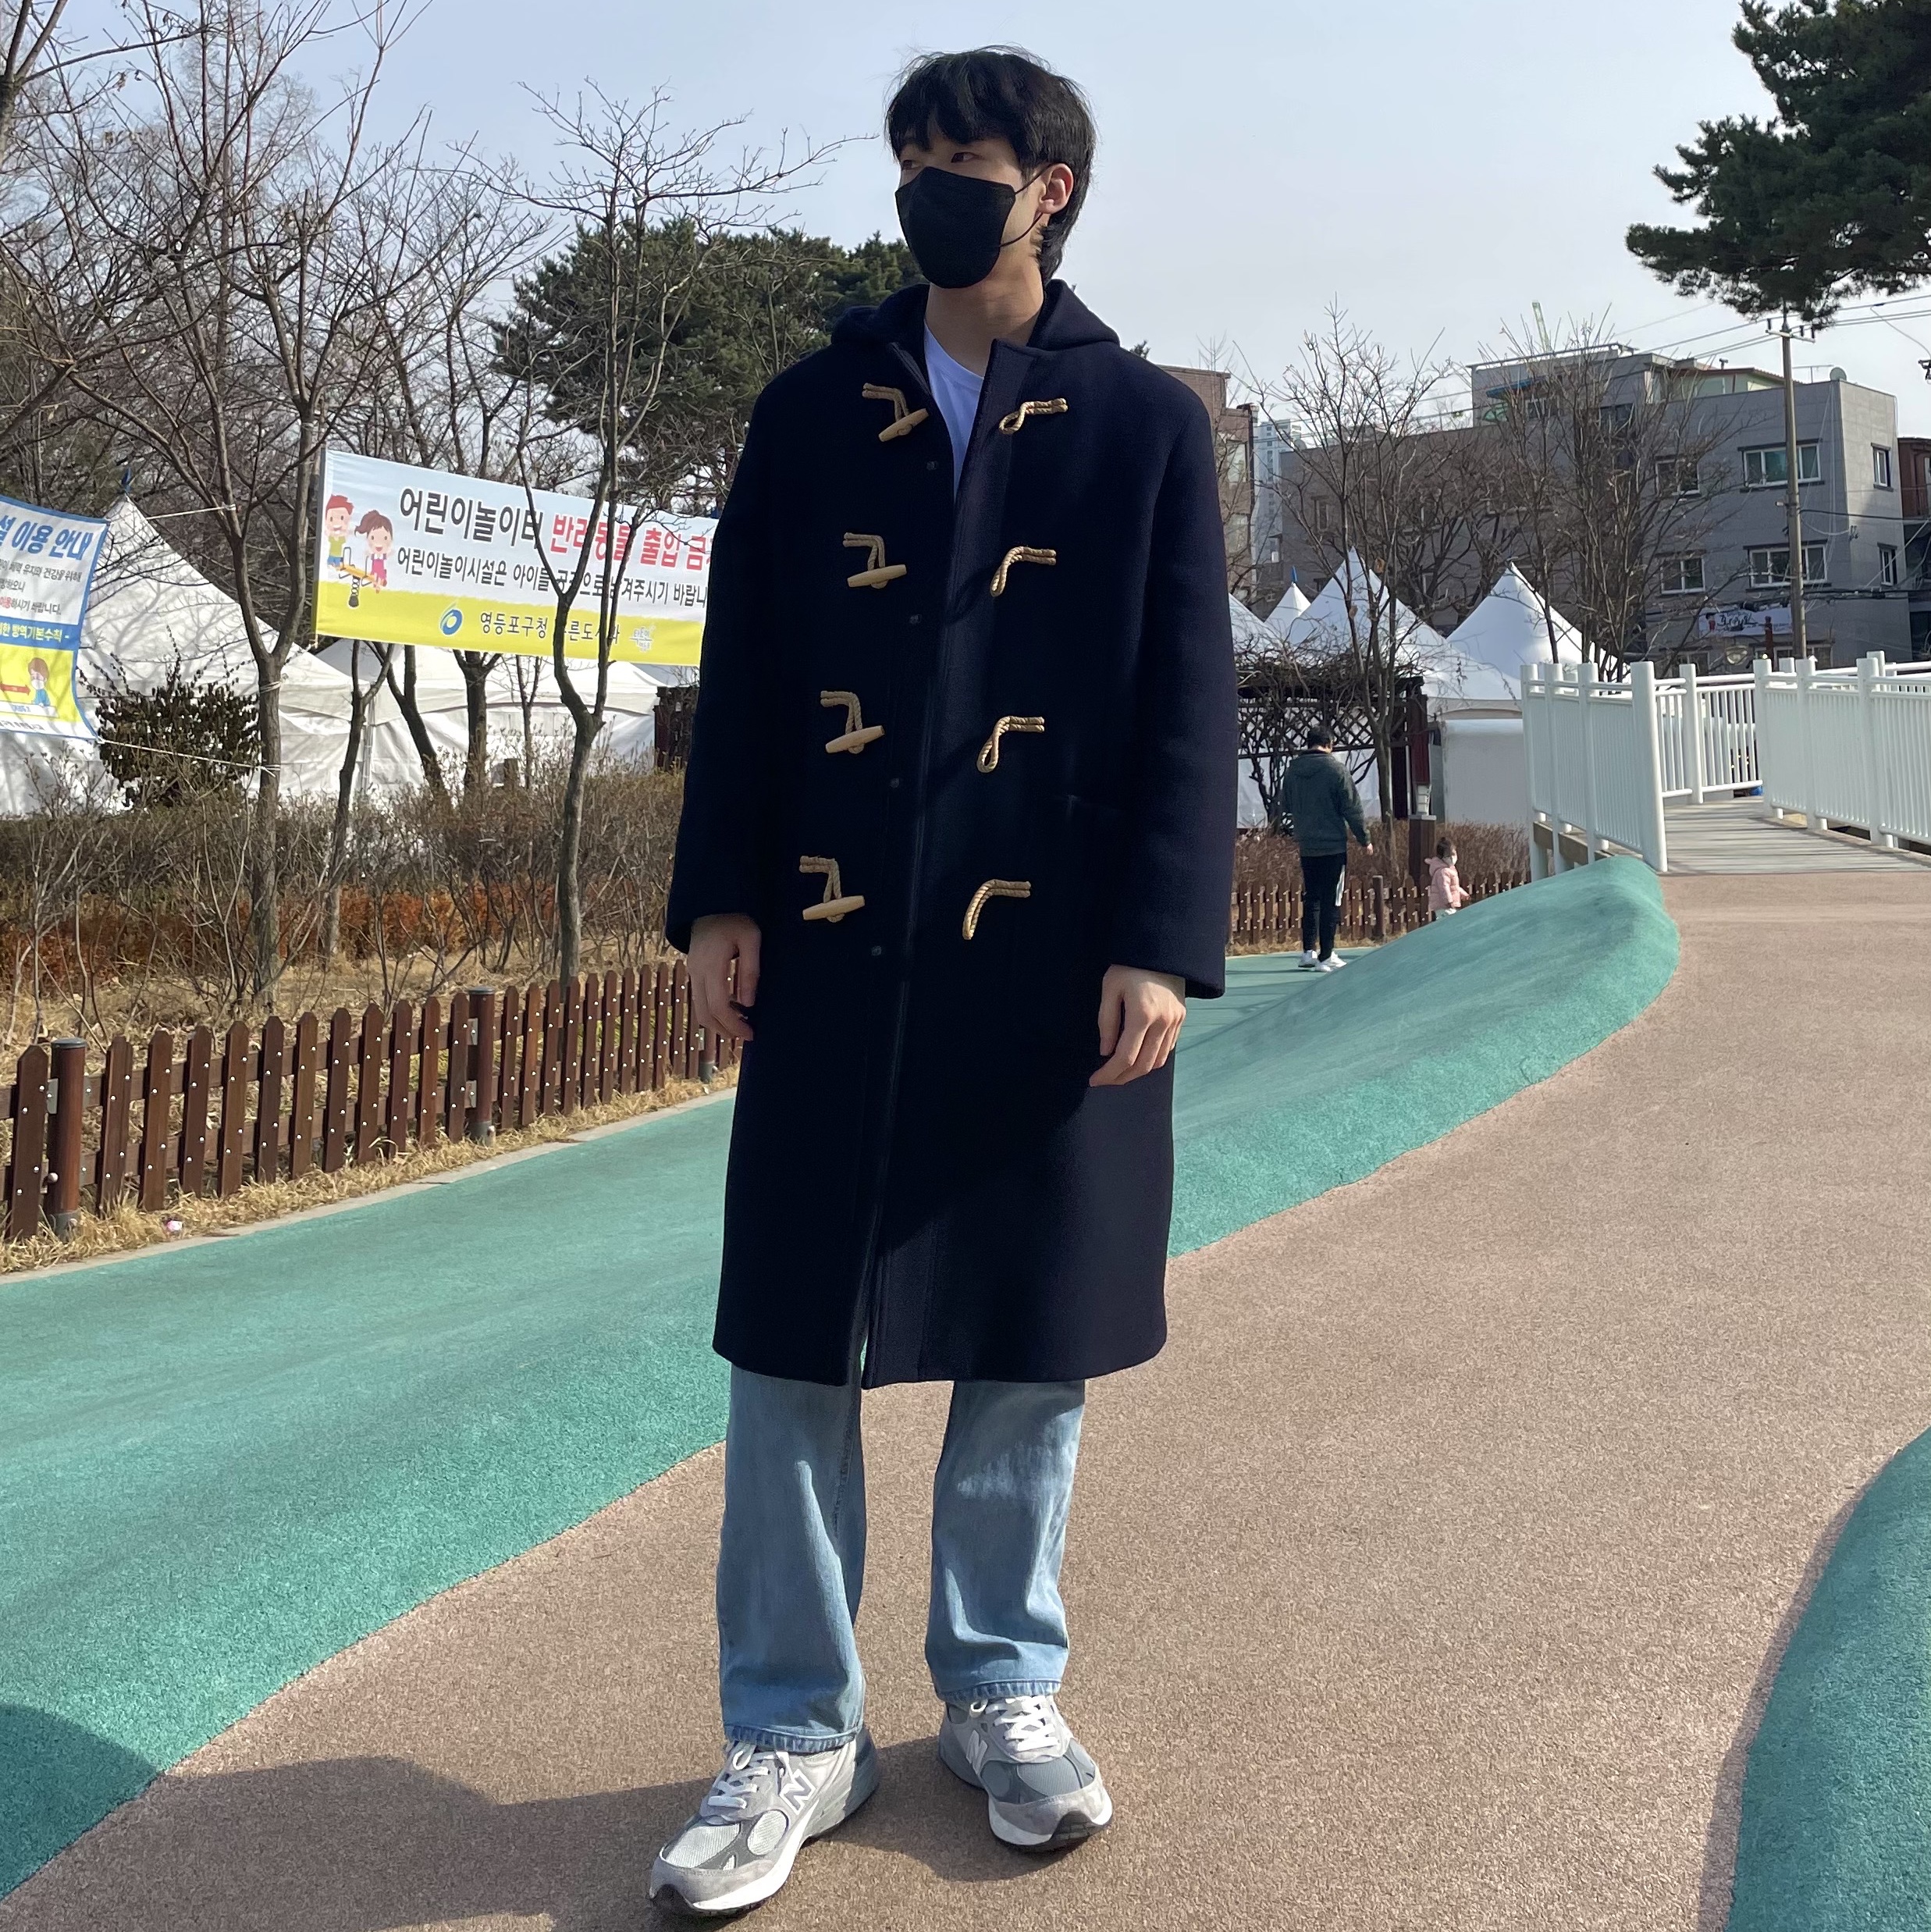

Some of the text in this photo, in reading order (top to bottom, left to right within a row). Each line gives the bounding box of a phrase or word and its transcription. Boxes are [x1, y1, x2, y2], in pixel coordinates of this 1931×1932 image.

[12, 521, 53, 554] 이용
[48, 528, 94, 560] 안내
[400, 488, 544, 549] 어린이놀이터
[640, 528, 681, 568] 출입
[686, 535, 713, 571] 금
[397, 547, 507, 587] 어린이놀이시설은
[513, 564, 550, 592] 아이들
[556, 569, 606, 596] 공으로
[673, 582, 708, 609] 바랍니
[480, 611, 548, 639] 영등포구청
[780, 1768, 817, 1815] N
